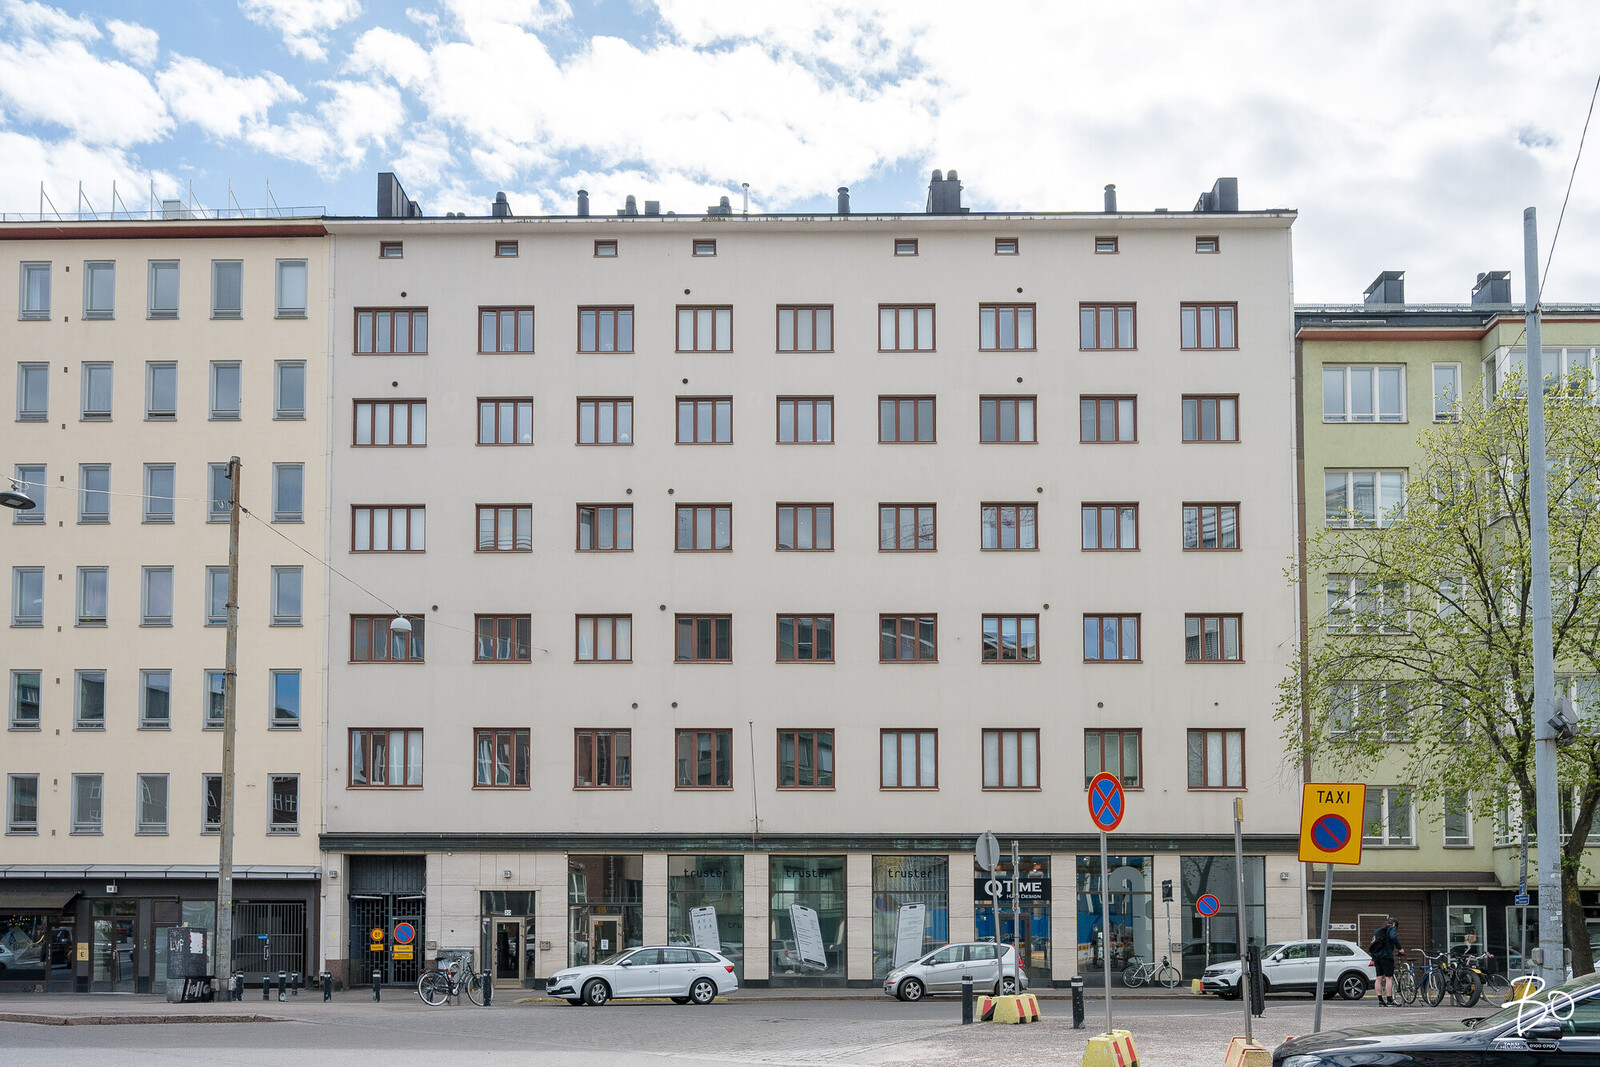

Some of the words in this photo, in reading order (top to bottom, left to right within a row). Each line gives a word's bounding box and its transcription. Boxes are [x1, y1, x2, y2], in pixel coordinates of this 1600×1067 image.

[1317, 791, 1350, 803] TAXI
[684, 868, 729, 878] truster
[786, 868, 832, 878] truster
[888, 868, 933, 878] truster
